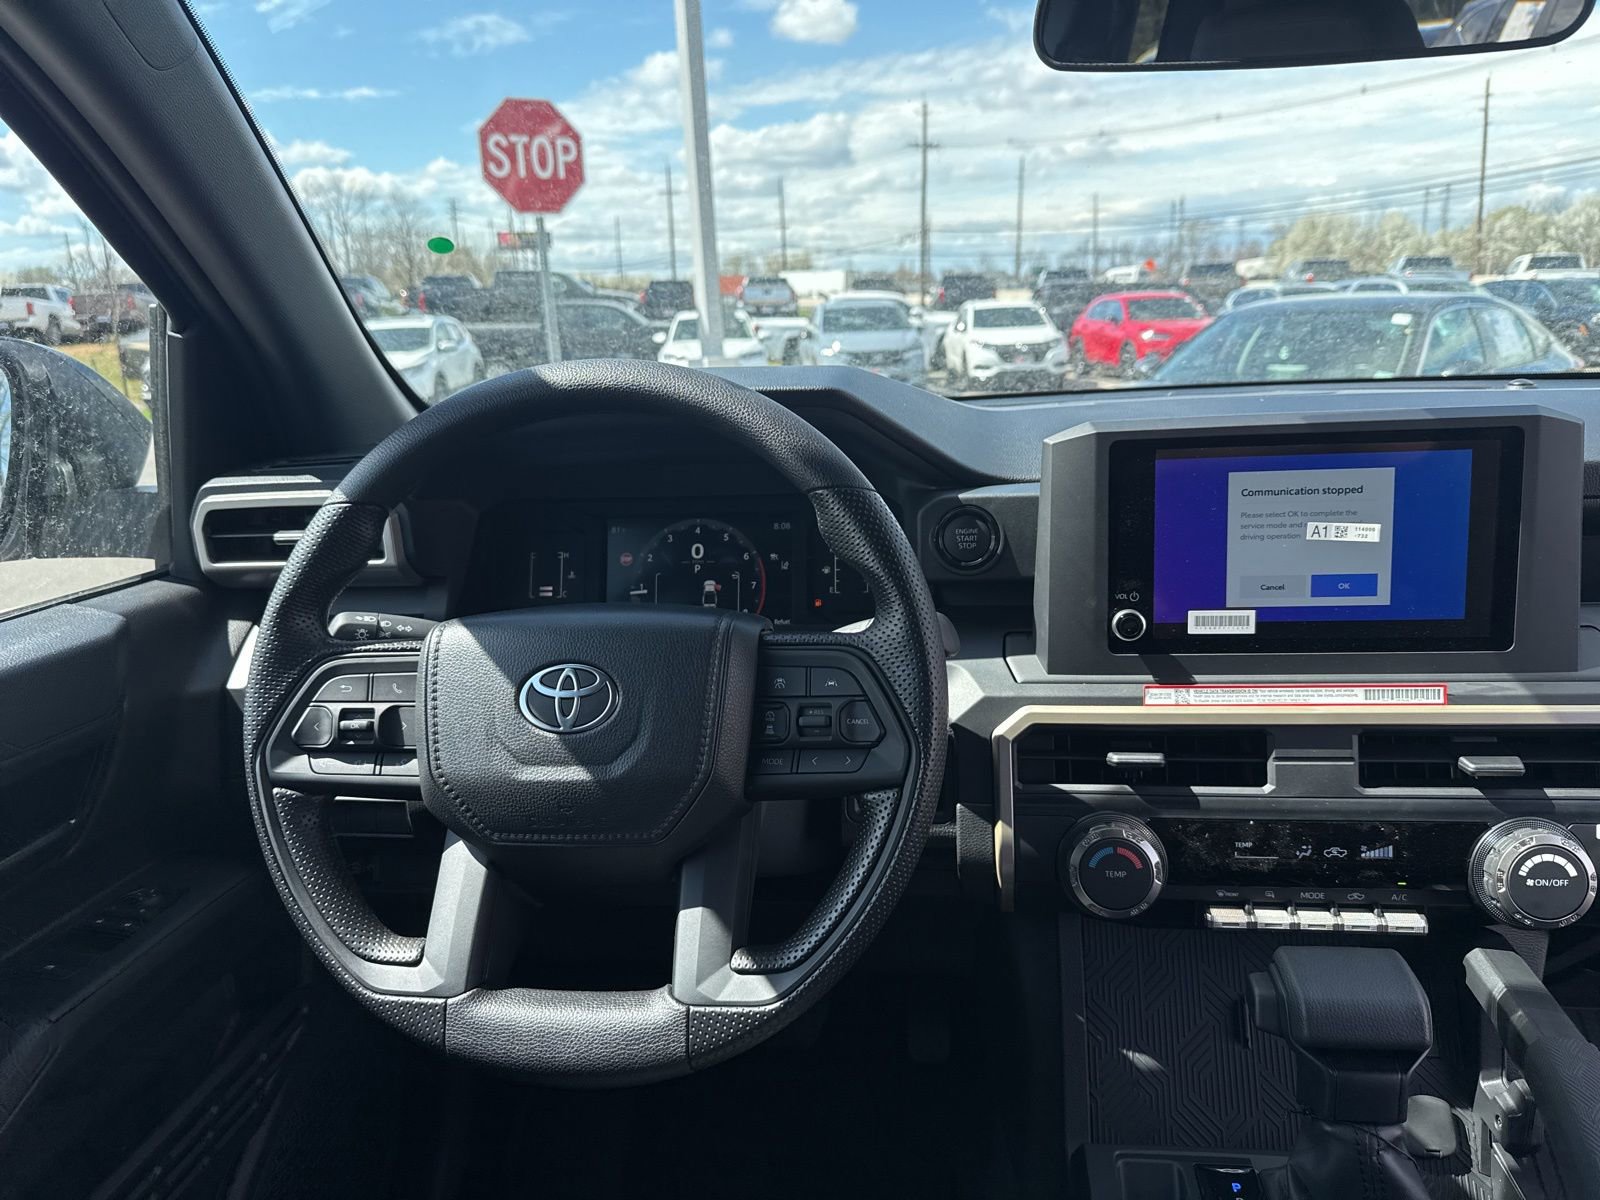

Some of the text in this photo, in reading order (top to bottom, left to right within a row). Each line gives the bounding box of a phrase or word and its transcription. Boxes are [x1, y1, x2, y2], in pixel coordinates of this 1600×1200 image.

[486, 133, 578, 180] STOP
[1241, 485, 1364, 498] Communication stopped
[1240, 511, 1264, 519] Please
[1287, 510, 1299, 518] OK
[1309, 509, 1344, 519] complete
[1345, 509, 1358, 517] the
[1289, 521, 1303, 529] and
[695, 526, 701, 535] 4
[1310, 525, 1329, 538] A1
[667, 534, 673, 543] 3
[723, 533, 729, 541] 5
[1240, 532, 1301, 541] driving operation
[647, 553, 653, 562] 2
[743, 552, 750, 561] 6
[694, 564, 701, 574] P
[751, 581, 757, 590] 7
[1260, 583, 1285, 591] Cancel
[1337, 582, 1351, 590] OK
[762, 758, 784, 766] MODE
[1234, 841, 1253, 849] TEMP
[1105, 870, 1127, 878] TEMP
[1534, 879, 1569, 887] ON/OFF
[1300, 891, 1326, 900] MODE
[1391, 893, 1408, 902] A/C
[1231, 1182, 1242, 1192] P
